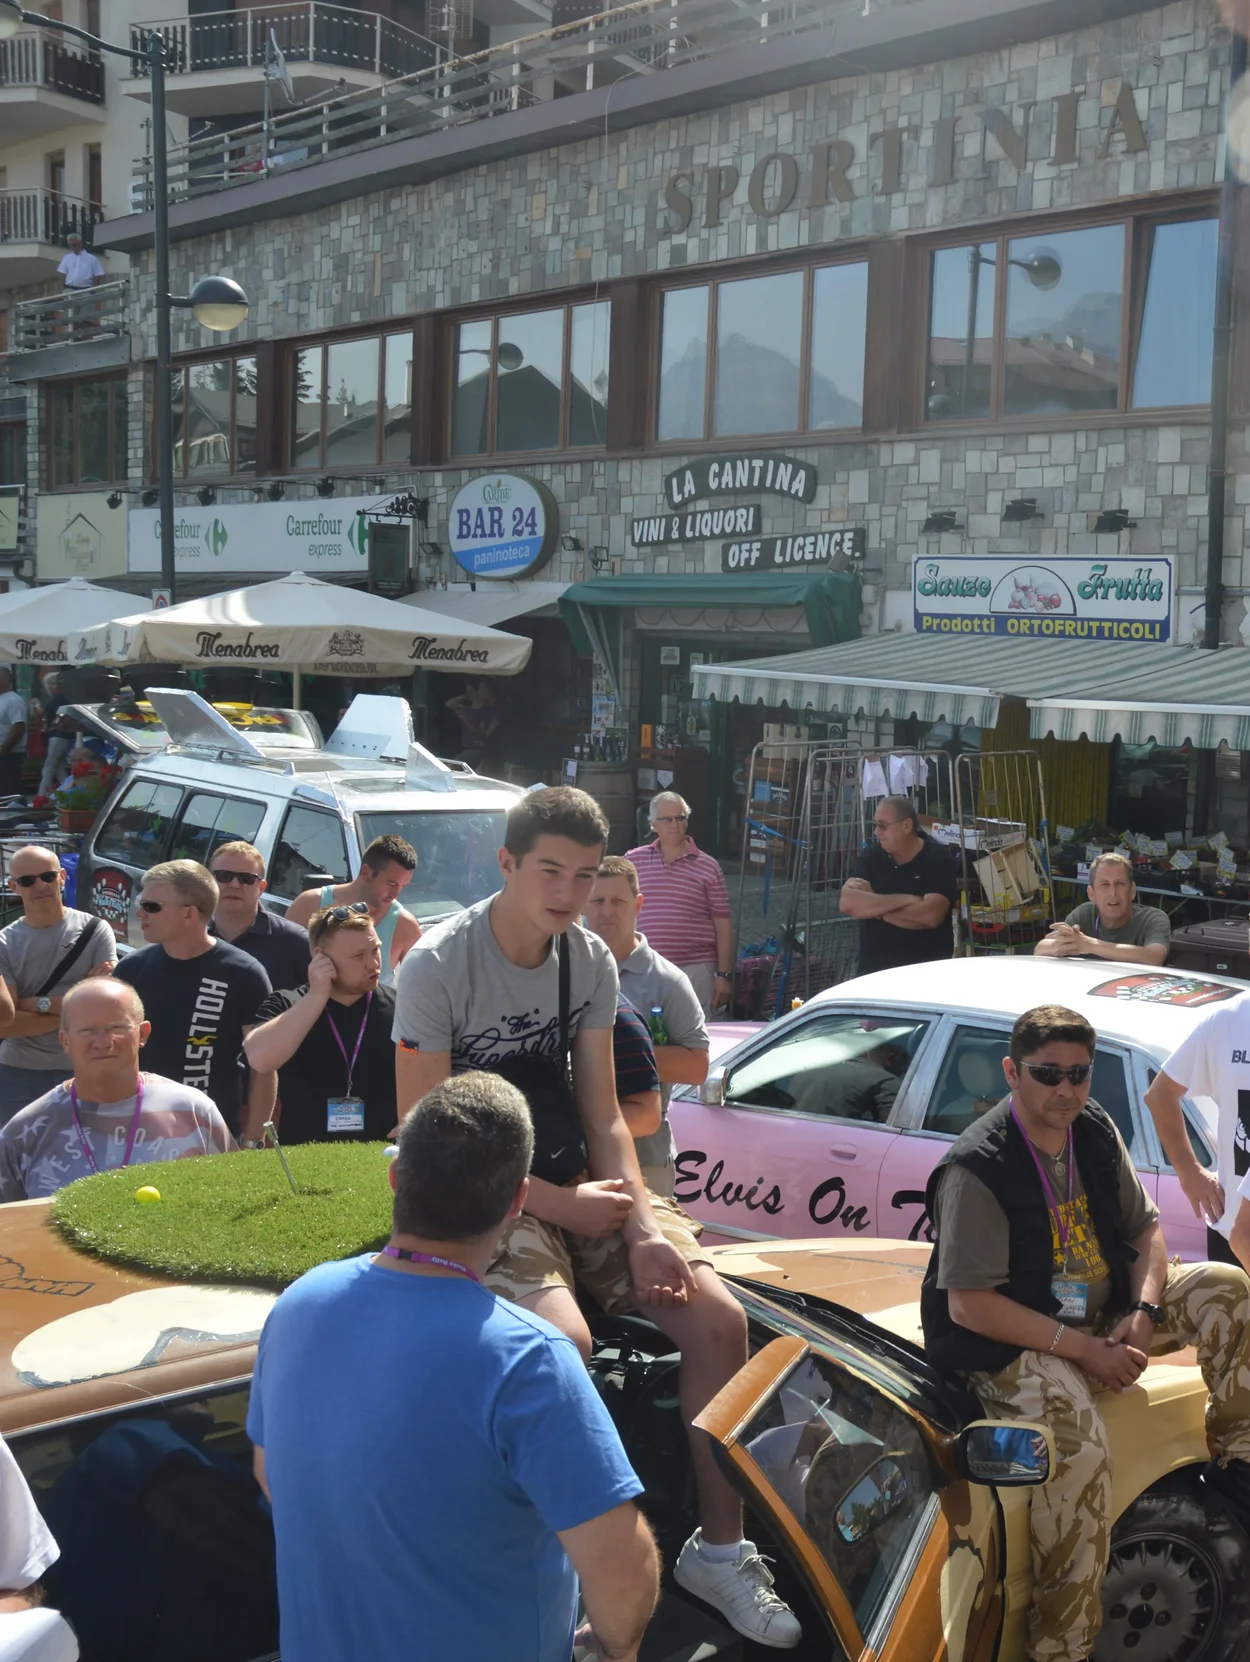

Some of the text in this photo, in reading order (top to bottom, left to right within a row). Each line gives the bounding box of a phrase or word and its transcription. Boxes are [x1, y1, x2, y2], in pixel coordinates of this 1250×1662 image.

[662, 82, 1147, 237] SPORTINIA
[671, 458, 806, 503] LA CANTINA
[155, 518, 201, 539] Cefour
[286, 513, 343, 537] Carrefour
[457, 506, 538, 539] BAR 24
[633, 506, 754, 543] VINI & LIQUORI
[308, 542, 342, 557] express
[474, 545, 531, 569] paninoteca
[728, 541, 761, 567] OFF
[917, 563, 1164, 602] Sauze Frutta
[922, 615, 1161, 640] Prodotti ORTOFRUTTICOLI
[15, 638, 68, 662] Menab
[196, 631, 280, 659] Menabrea
[407, 636, 489, 663] Menabrea
[113, 1125, 181, 1161] COAS
[672, 1150, 785, 1215] Elvis
[808, 1176, 871, 1232] On
